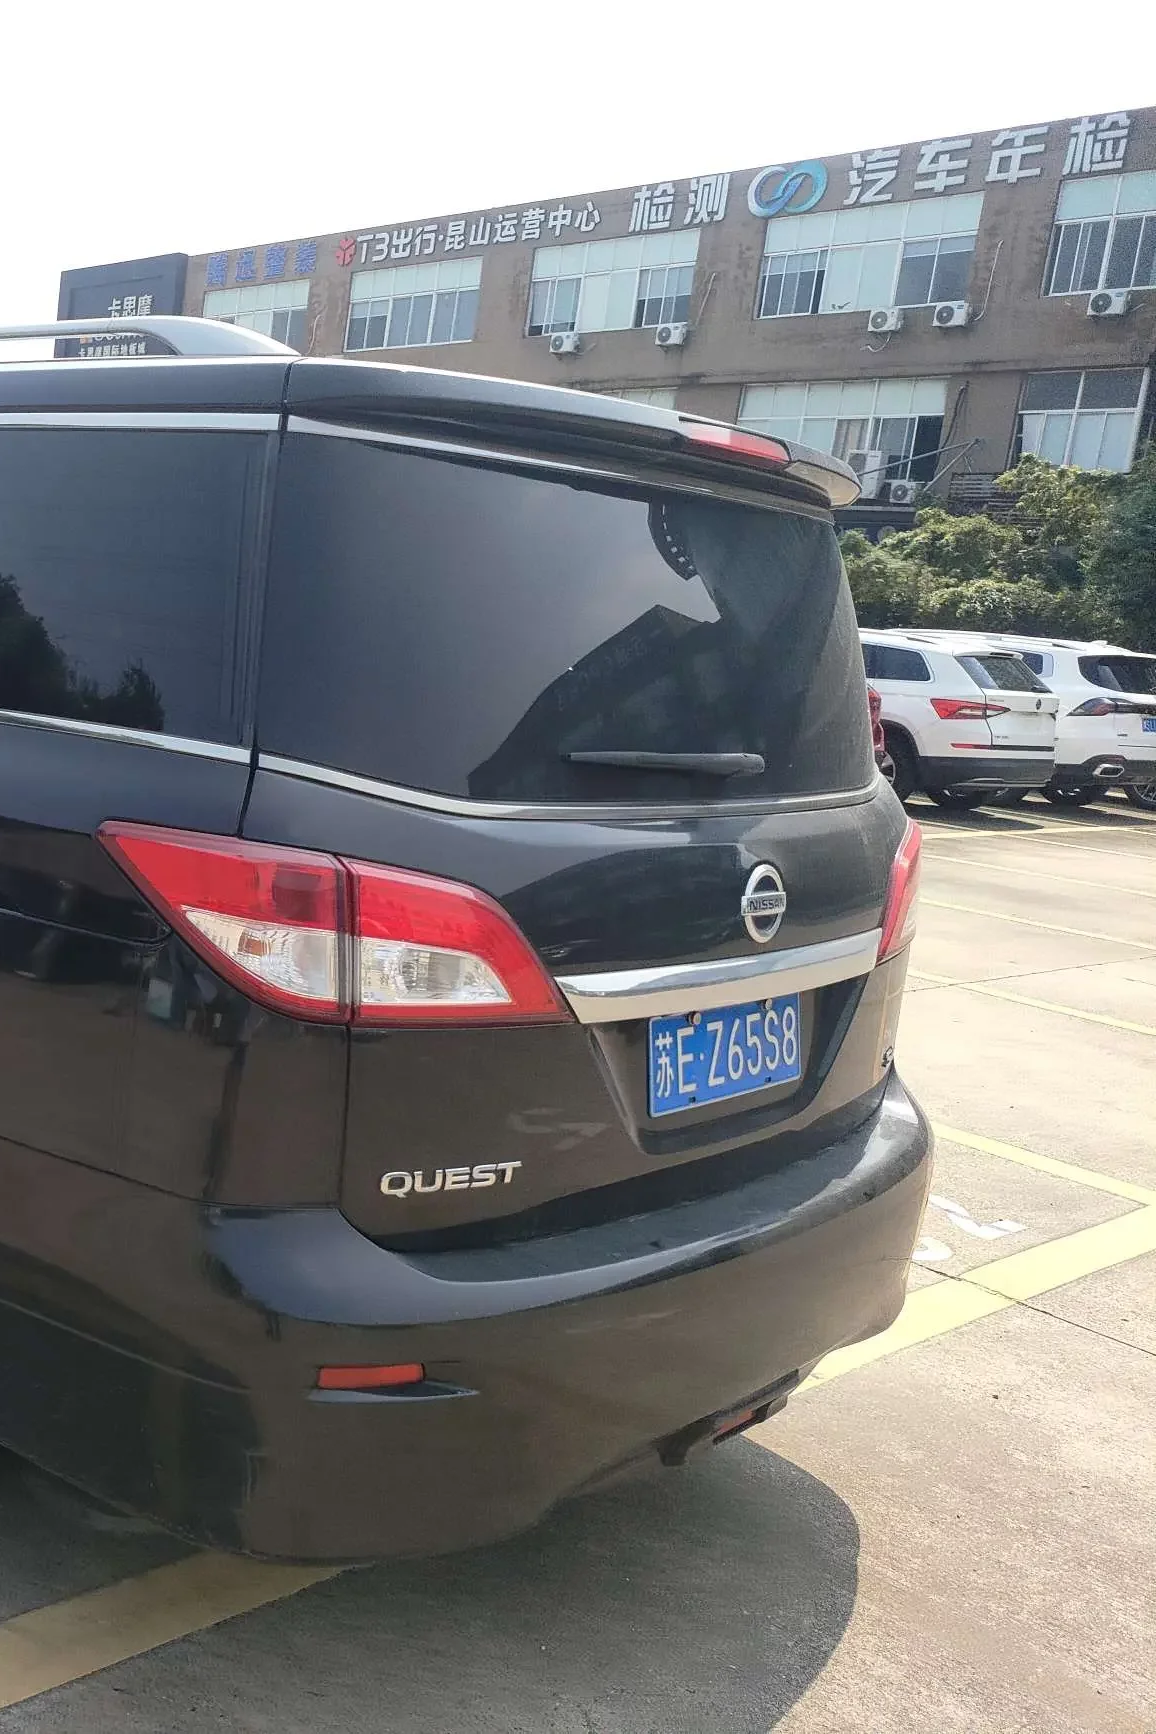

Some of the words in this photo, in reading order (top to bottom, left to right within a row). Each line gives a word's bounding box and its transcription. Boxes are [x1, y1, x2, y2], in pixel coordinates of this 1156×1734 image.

[628, 173, 732, 233] 检测
[843, 111, 1132, 207] 汽车年检
[356, 201, 601, 264] T3出行·昆山运营中心
[749, 896, 784, 911] NISSAN
[380, 1160, 523, 1198] QUEST
